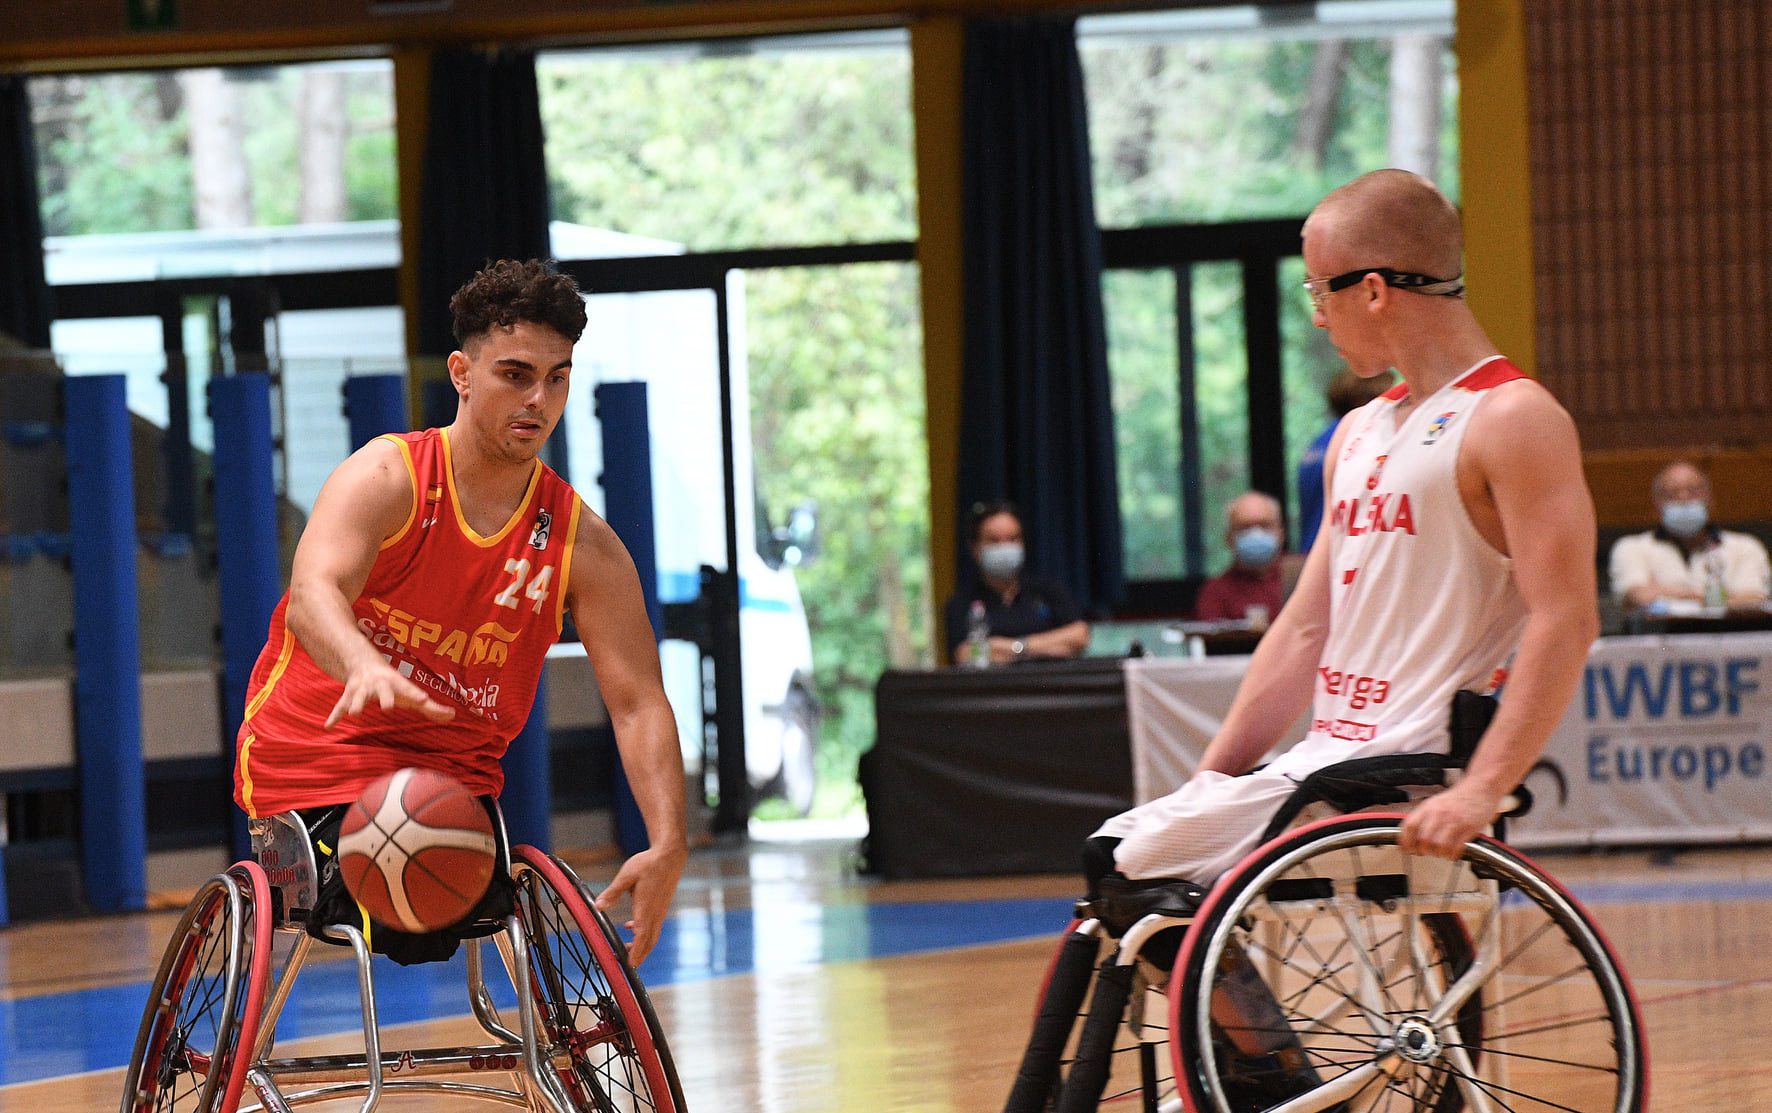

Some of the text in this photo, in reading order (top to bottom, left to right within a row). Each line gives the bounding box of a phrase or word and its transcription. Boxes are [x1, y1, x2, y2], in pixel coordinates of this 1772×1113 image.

[494, 557, 555, 615] 24
[415, 669, 469, 707] SEGUROS
[1584, 657, 1760, 720] IWBF
[1587, 735, 1765, 791] Europe
